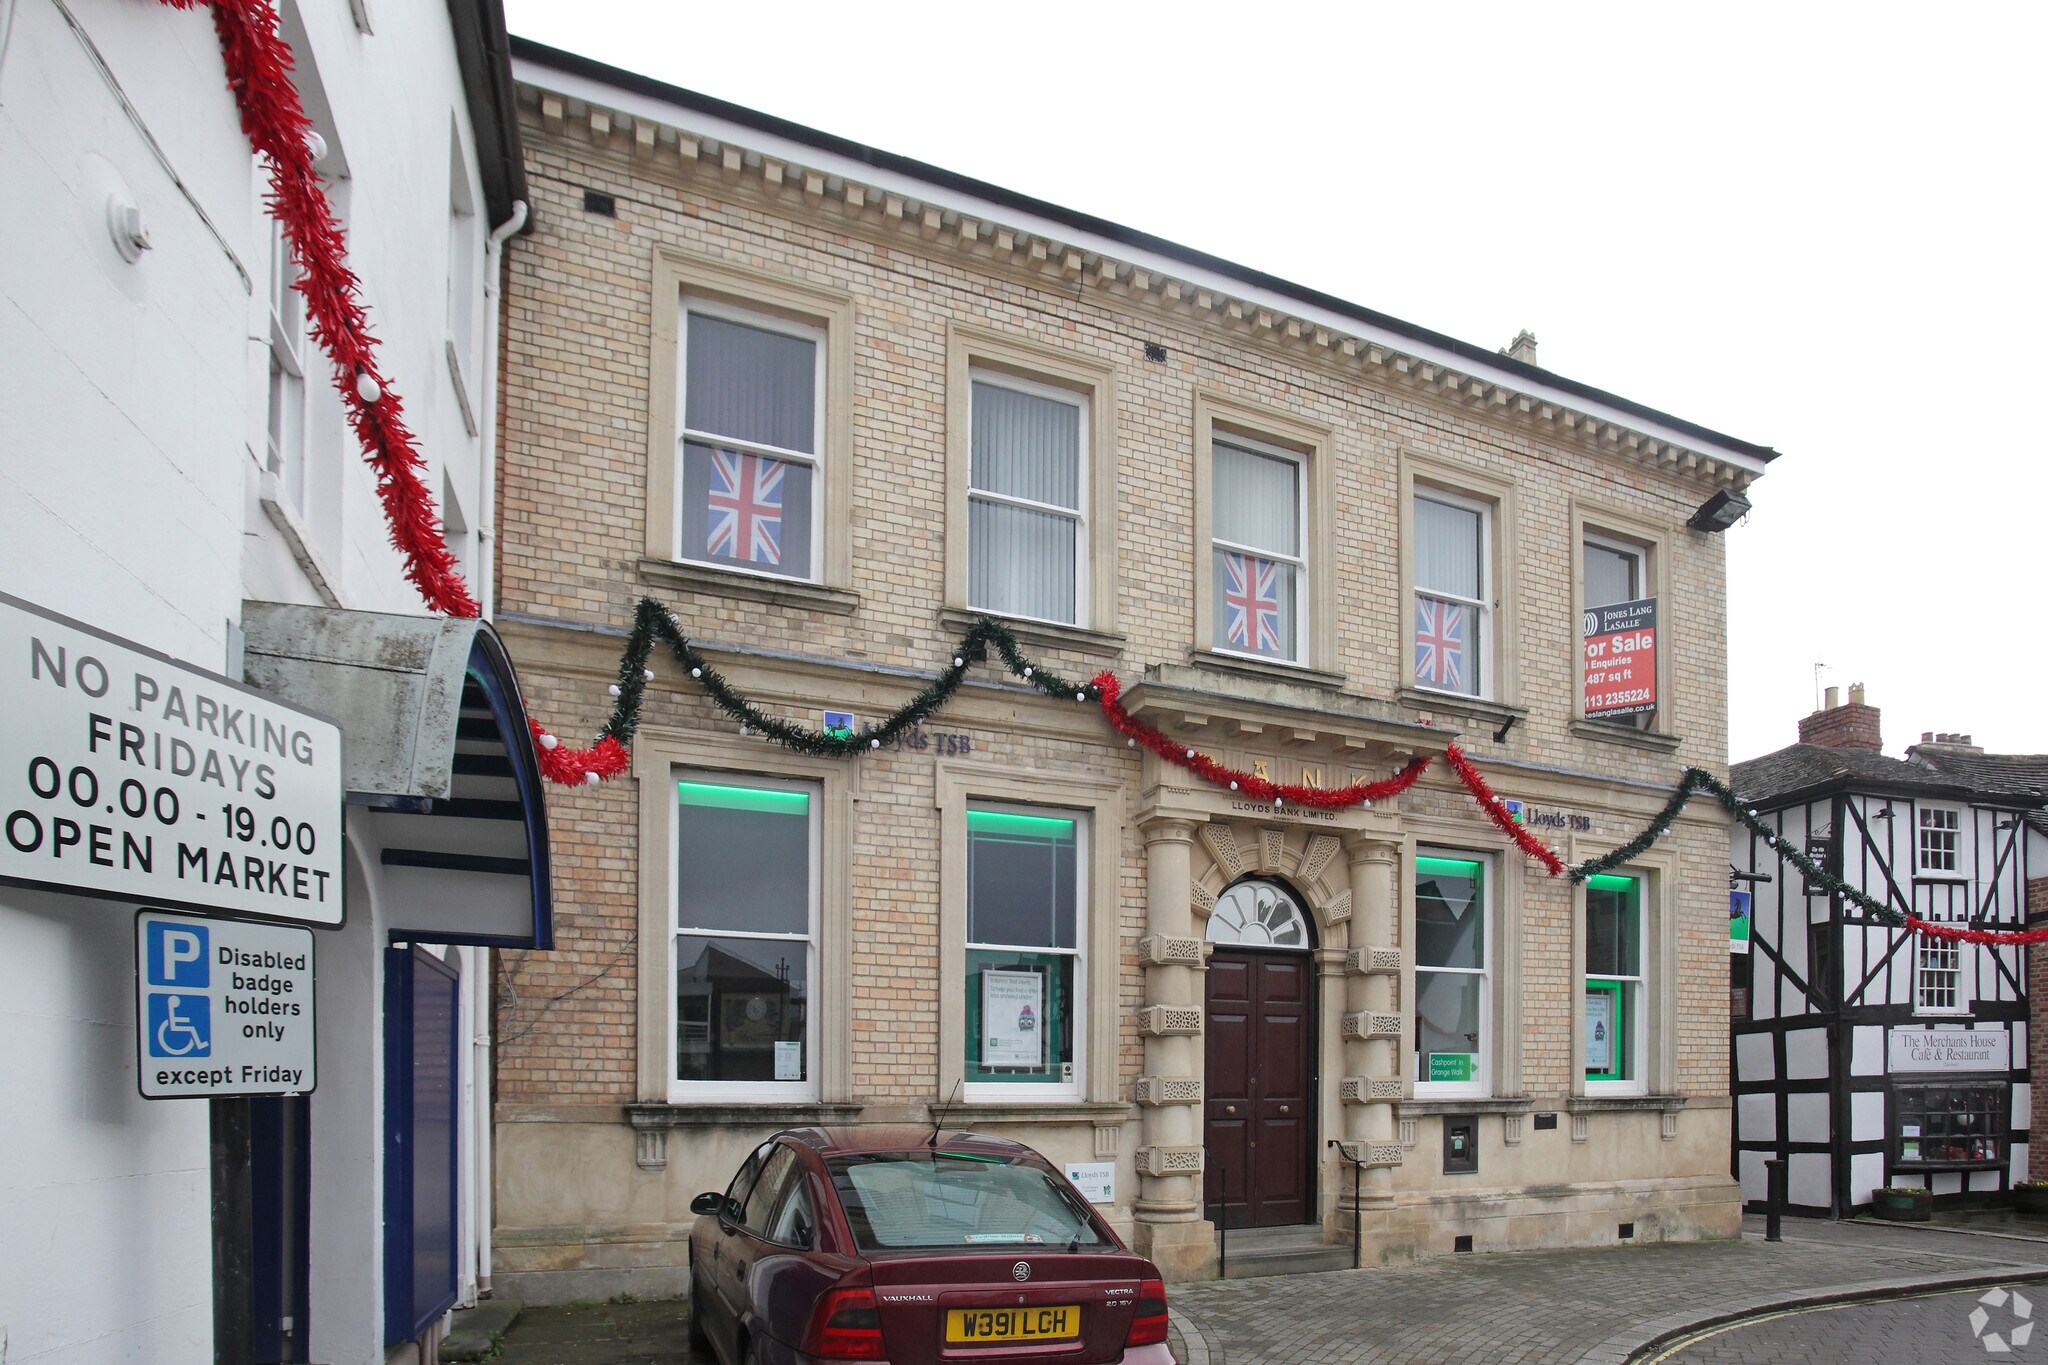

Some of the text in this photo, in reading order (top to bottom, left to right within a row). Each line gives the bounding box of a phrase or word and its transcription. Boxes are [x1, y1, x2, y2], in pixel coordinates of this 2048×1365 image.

[1604, 606, 1652, 622] JONES LANG
[1612, 633, 1652, 654] Sale
[1591, 657, 1632, 669] Enquiries
[1609, 673, 1621, 682] sq
[1623, 669, 1632, 679] ft
[31, 636, 313, 766] NO PARKING
[1606, 688, 1649, 705] 2355224
[933, 733, 971, 753] TSB
[90, 712, 275, 800] FRIDAYS
[1199, 753, 1368, 790] ANK
[29, 756, 179, 825] 00.00
[222, 804, 315, 855] 19.00
[1232, 801, 1270, 814] LLOYDS
[1274, 805, 1299, 817] BANK
[1527, 808, 1590, 831] Lloyds TSB
[6, 810, 330, 902] OPEN MARKET
[164, 930, 200, 980] P
[219, 947, 305, 970] Disabled
[233, 972, 293, 995] badge
[225, 996, 300, 1016] holders
[243, 1021, 284, 1041] only
[1902, 1034, 1996, 1047] The Merchants House
[1431, 1059, 1456, 1067] Cashpoint
[1934, 1048, 1942, 1060] &
[1946, 1048, 1989, 1060] Restaurant
[157, 1066, 302, 1087] except Friday
[1431, 1069, 1450, 1077] Grange
[1081, 1171, 1099, 1179] Lloyds
[964, 1310, 1066, 1337] W391 LCH
